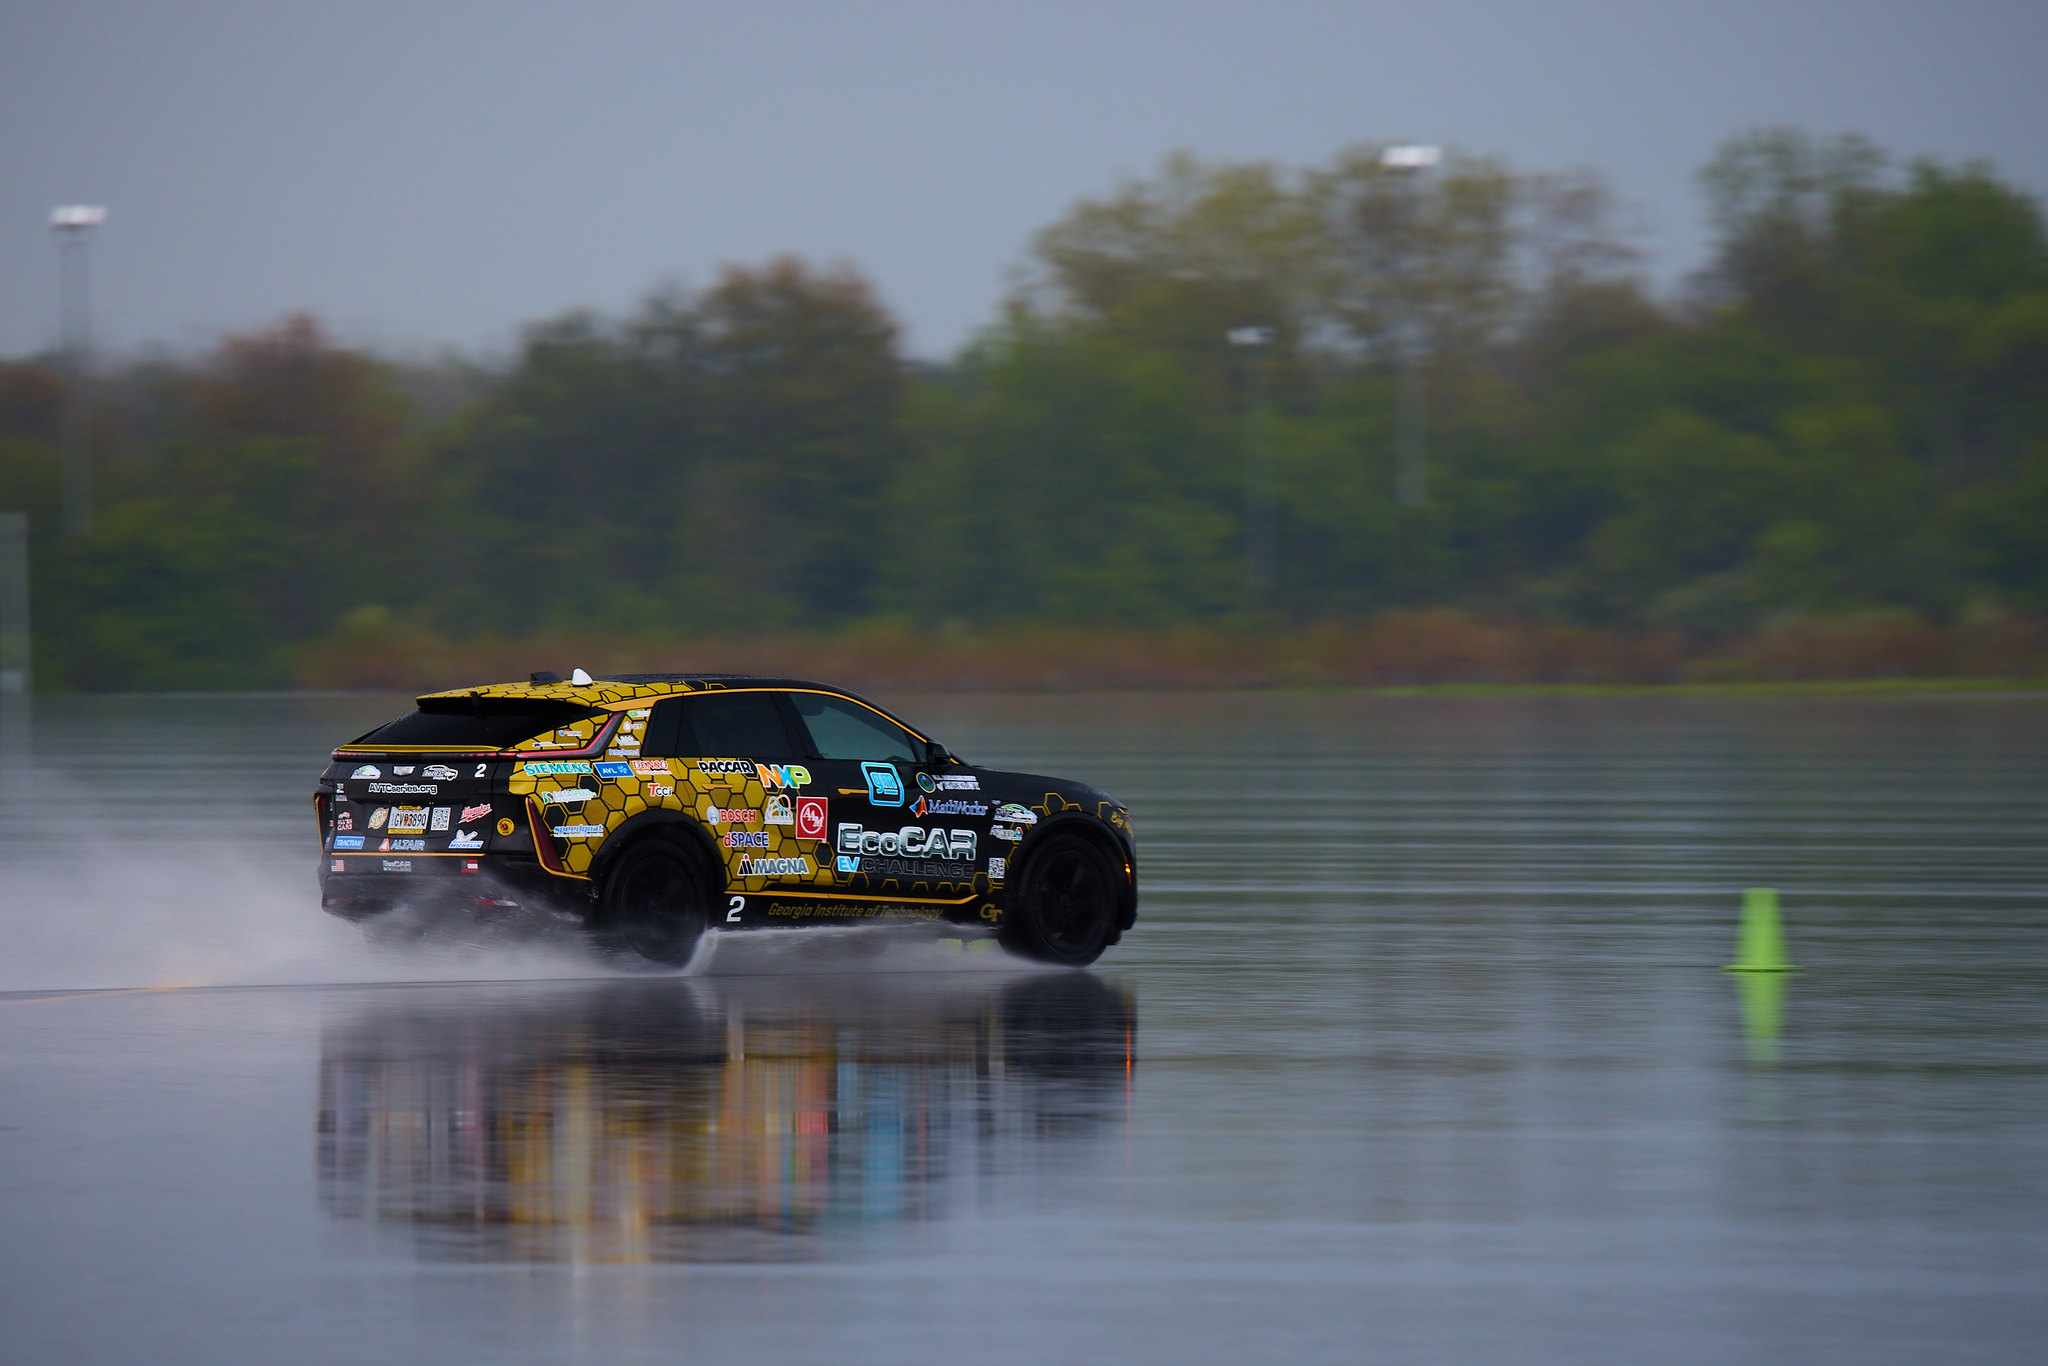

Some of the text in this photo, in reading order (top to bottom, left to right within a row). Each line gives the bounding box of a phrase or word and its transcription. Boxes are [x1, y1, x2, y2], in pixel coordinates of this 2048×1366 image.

[474, 764, 487, 778] 2
[524, 762, 593, 776] SIEMENS
[602, 767, 618, 775] AVL
[633, 760, 668, 770] DENSO
[697, 760, 753, 774] PACCAR
[755, 763, 811, 788] NXP
[368, 783, 437, 795] AVTCseries.org
[869, 772, 898, 795] gm
[928, 799, 987, 815] MathWorks
[720, 809, 756, 822] BOSCH
[802, 806, 825, 827] AAM
[390, 840, 425, 851] ALTAIR
[723, 832, 769, 847] dSPACE
[837, 823, 977, 860] EcoCAR
[754, 858, 809, 874] MAGNA
[837, 856, 975, 878] EV CHALLENGE
[726, 895, 745, 922] 2
[768, 903, 944, 920] Georgia Institute of Technology
